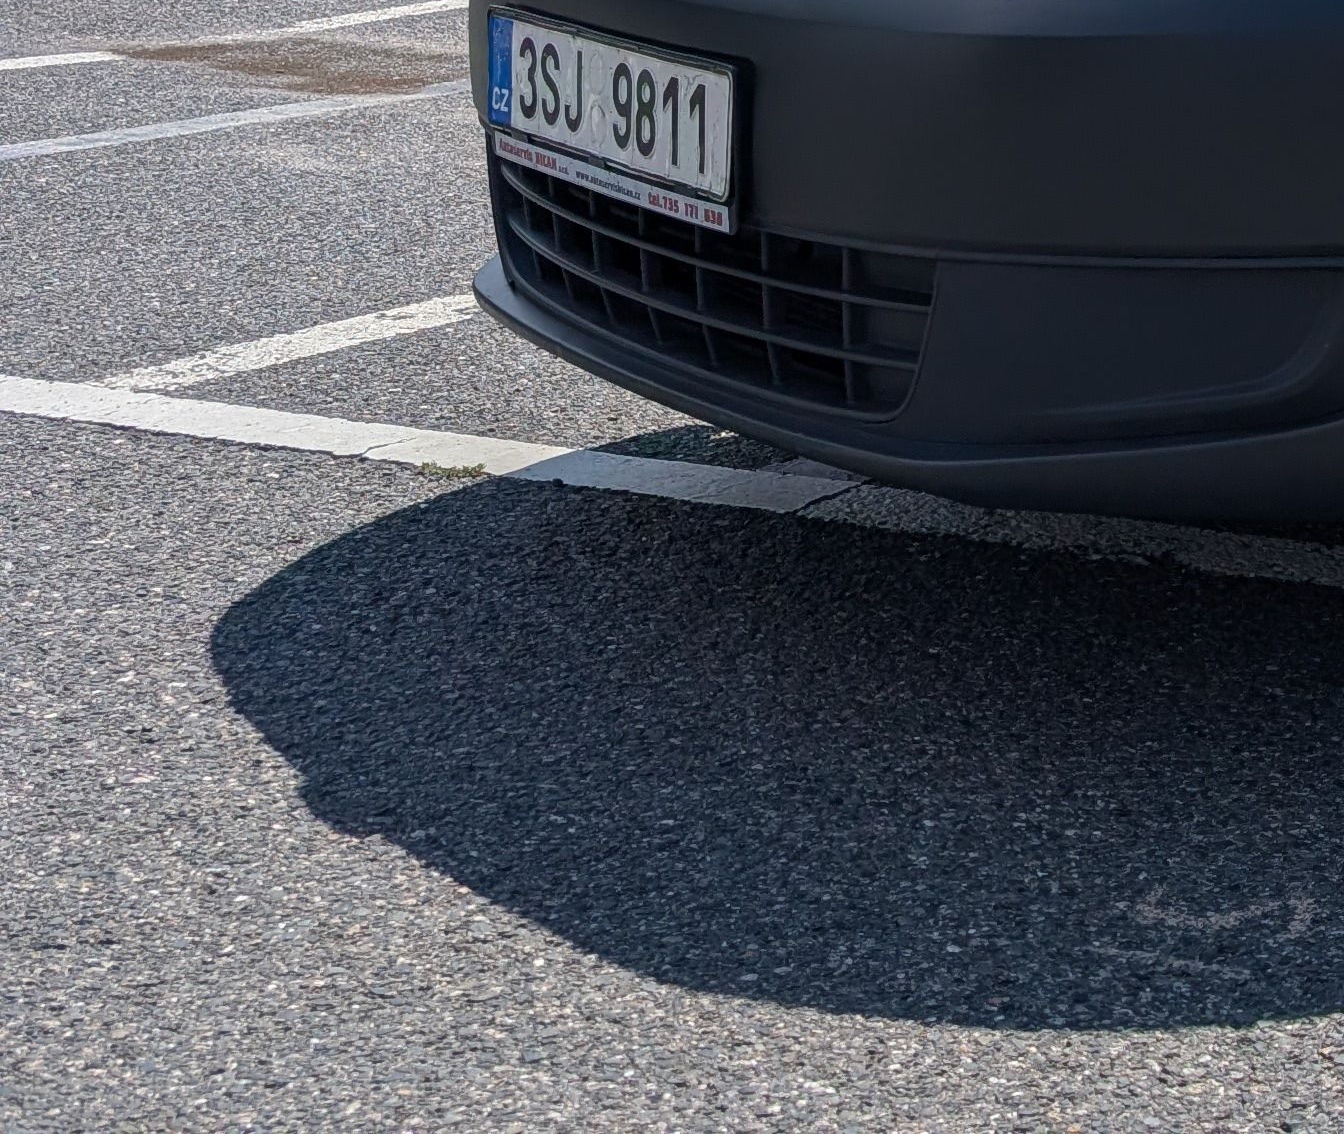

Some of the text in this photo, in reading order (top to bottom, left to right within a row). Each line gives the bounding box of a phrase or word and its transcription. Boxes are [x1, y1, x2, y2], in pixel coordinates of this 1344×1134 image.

[491, 86, 509, 112] CZ
[519, 37, 706, 175] 3SJ 9811
